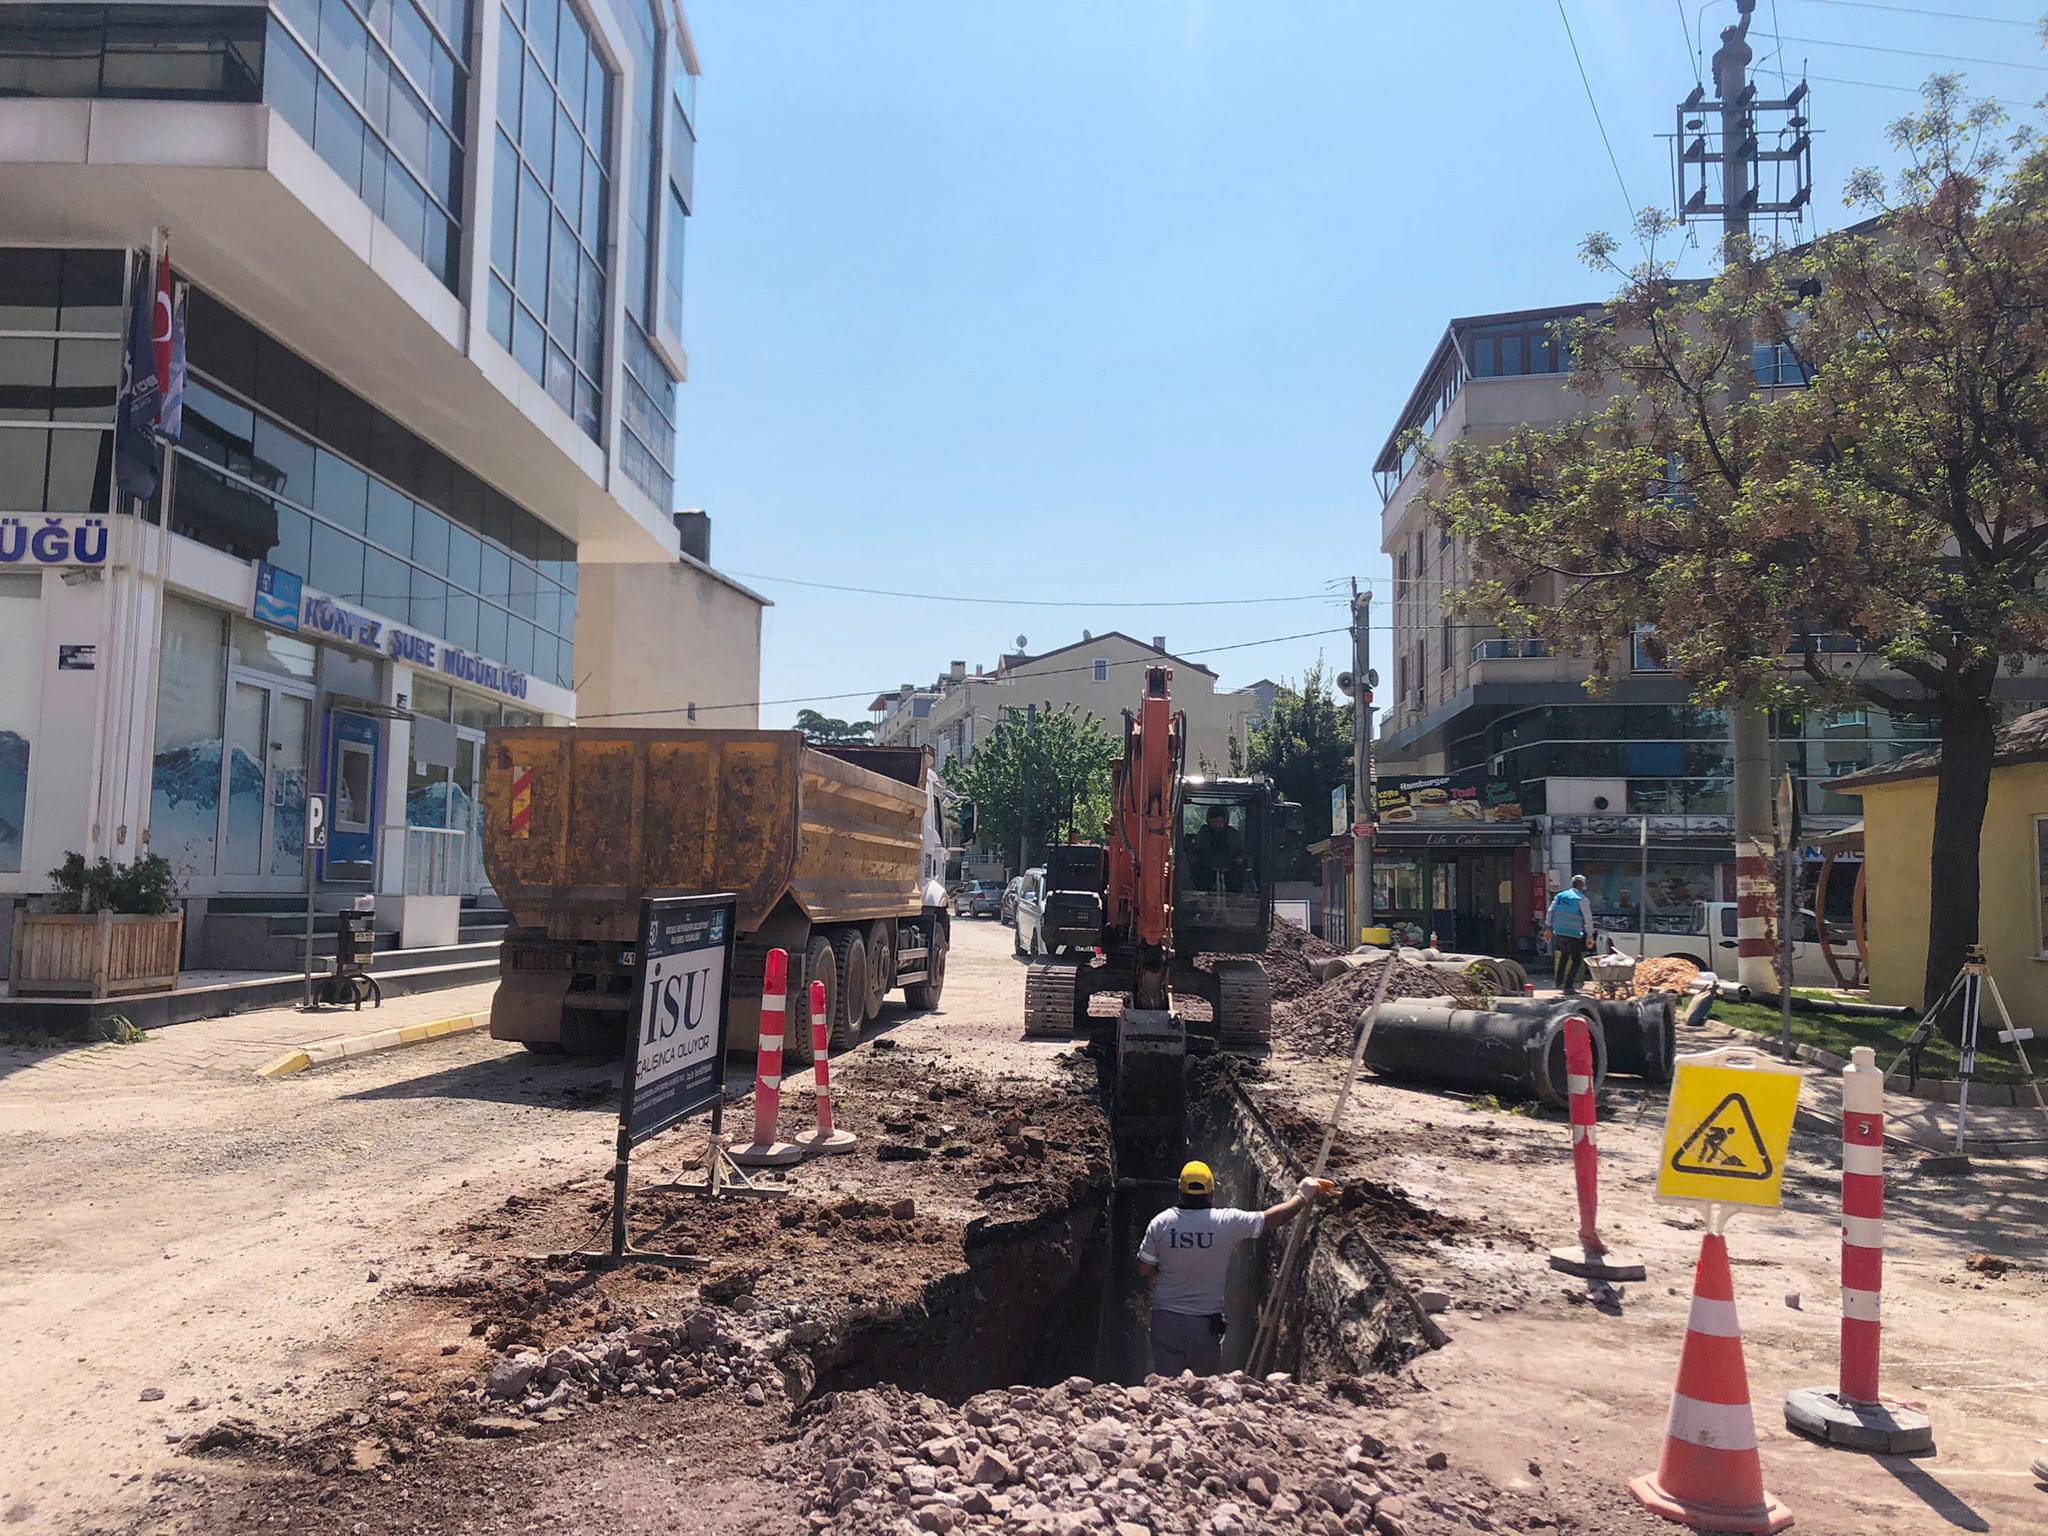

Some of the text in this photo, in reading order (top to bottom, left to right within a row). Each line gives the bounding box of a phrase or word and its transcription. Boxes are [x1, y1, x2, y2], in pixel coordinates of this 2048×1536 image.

[389, 629, 435, 667] ŞUBE
[443, 648, 528, 700] MÜDÜRLÜĞÜ
[1400, 777, 1450, 790] Hamburger
[309, 796, 323, 844] P
[644, 962, 710, 1047] İSU
[677, 1034, 710, 1058] OLUYOR
[1170, 1228, 1214, 1249] İSU
